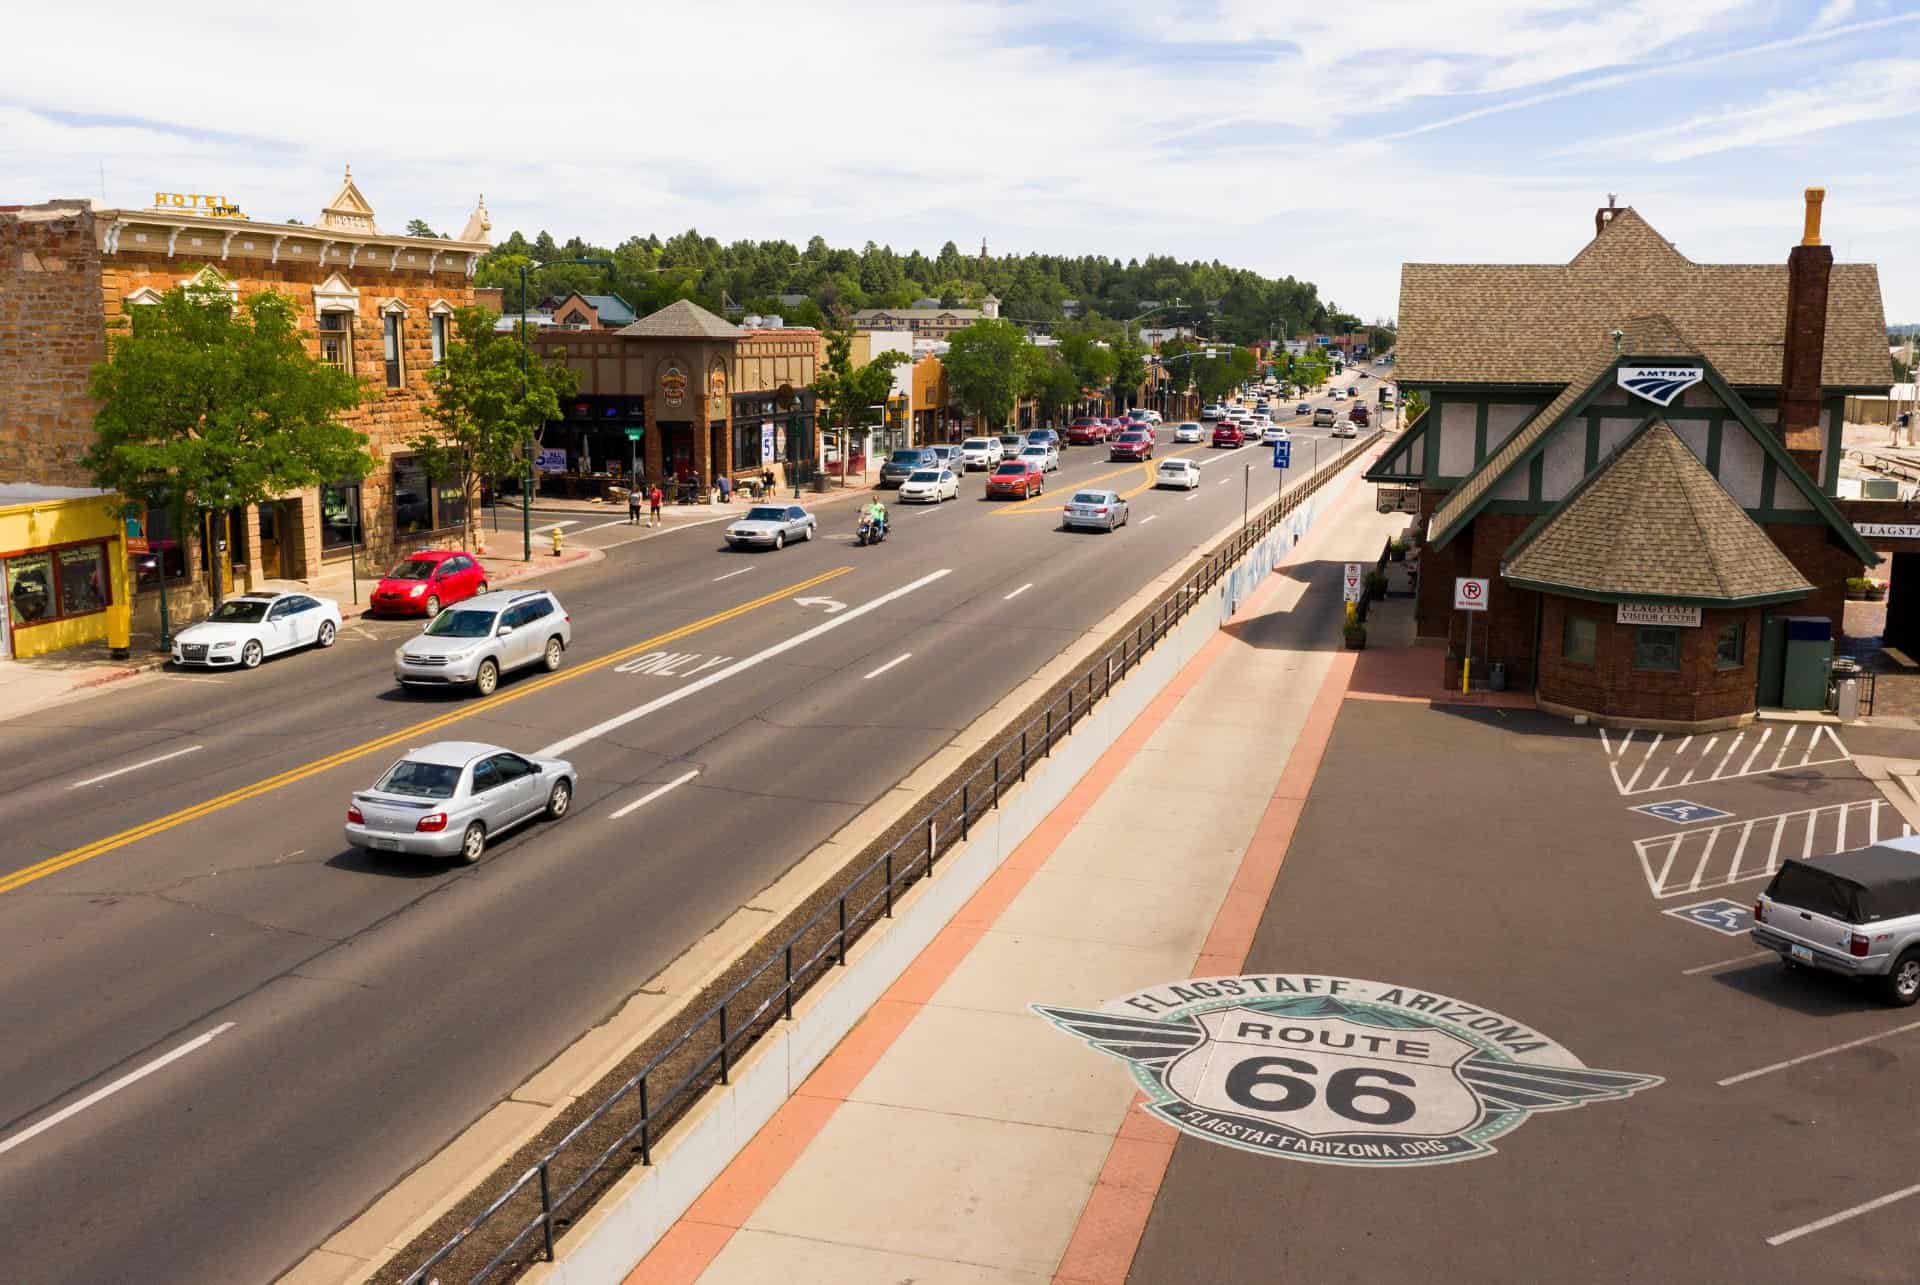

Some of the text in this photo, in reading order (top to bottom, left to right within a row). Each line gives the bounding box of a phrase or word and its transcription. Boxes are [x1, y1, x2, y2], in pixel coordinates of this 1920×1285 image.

[155, 192, 234, 209] HOTEL
[335, 215, 368, 227] HOTEL
[1276, 441, 1288, 456] H
[1621, 612, 1658, 622] VISITOR
[1622, 602, 1695, 615] FLAGSTAFF
[613, 651, 734, 678] ONLY
[1124, 977, 1549, 1054] FLAGSTAFF ARIZONA
[1236, 1021, 1430, 1058] ROUTE
[1225, 1056, 1417, 1125] 66
[1180, 1110, 1450, 1158] FLAGSTAFFARIZONA.ORG
